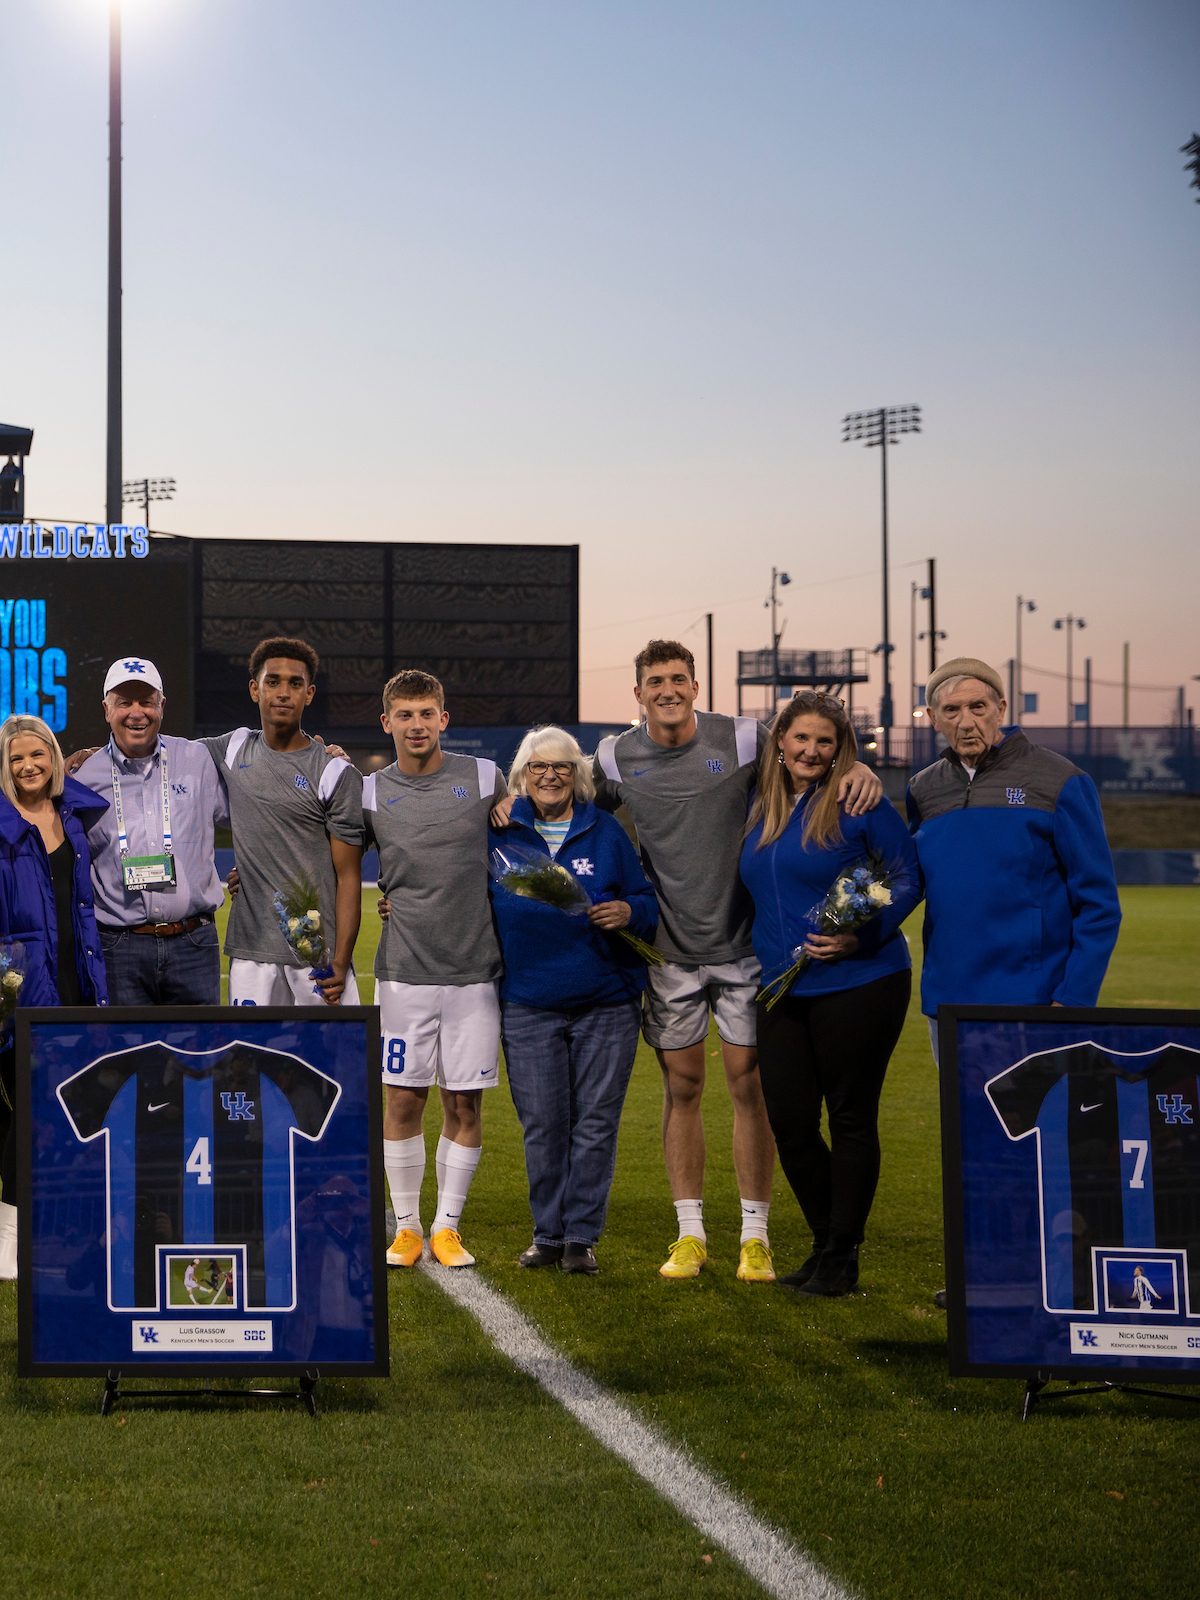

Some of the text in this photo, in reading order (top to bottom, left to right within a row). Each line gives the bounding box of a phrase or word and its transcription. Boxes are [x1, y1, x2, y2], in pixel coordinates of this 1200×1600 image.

[123, 661, 146, 674] UK
[706, 758, 725, 773] UK
[294, 773, 309, 790] UK
[451, 786, 468, 799] UK
[1005, 787, 1026, 804] UK
[571, 857, 595, 876] UK
[220, 1092, 256, 1120] UK
[1156, 1094, 1194, 1124] UK
[186, 1137, 212, 1185] 4
[1122, 1140, 1148, 1189] 7
[140, 1327, 159, 1343] UK
[1077, 1330, 1098, 1347] UK
[1136, 1332, 1169, 1340] GUTMANN
